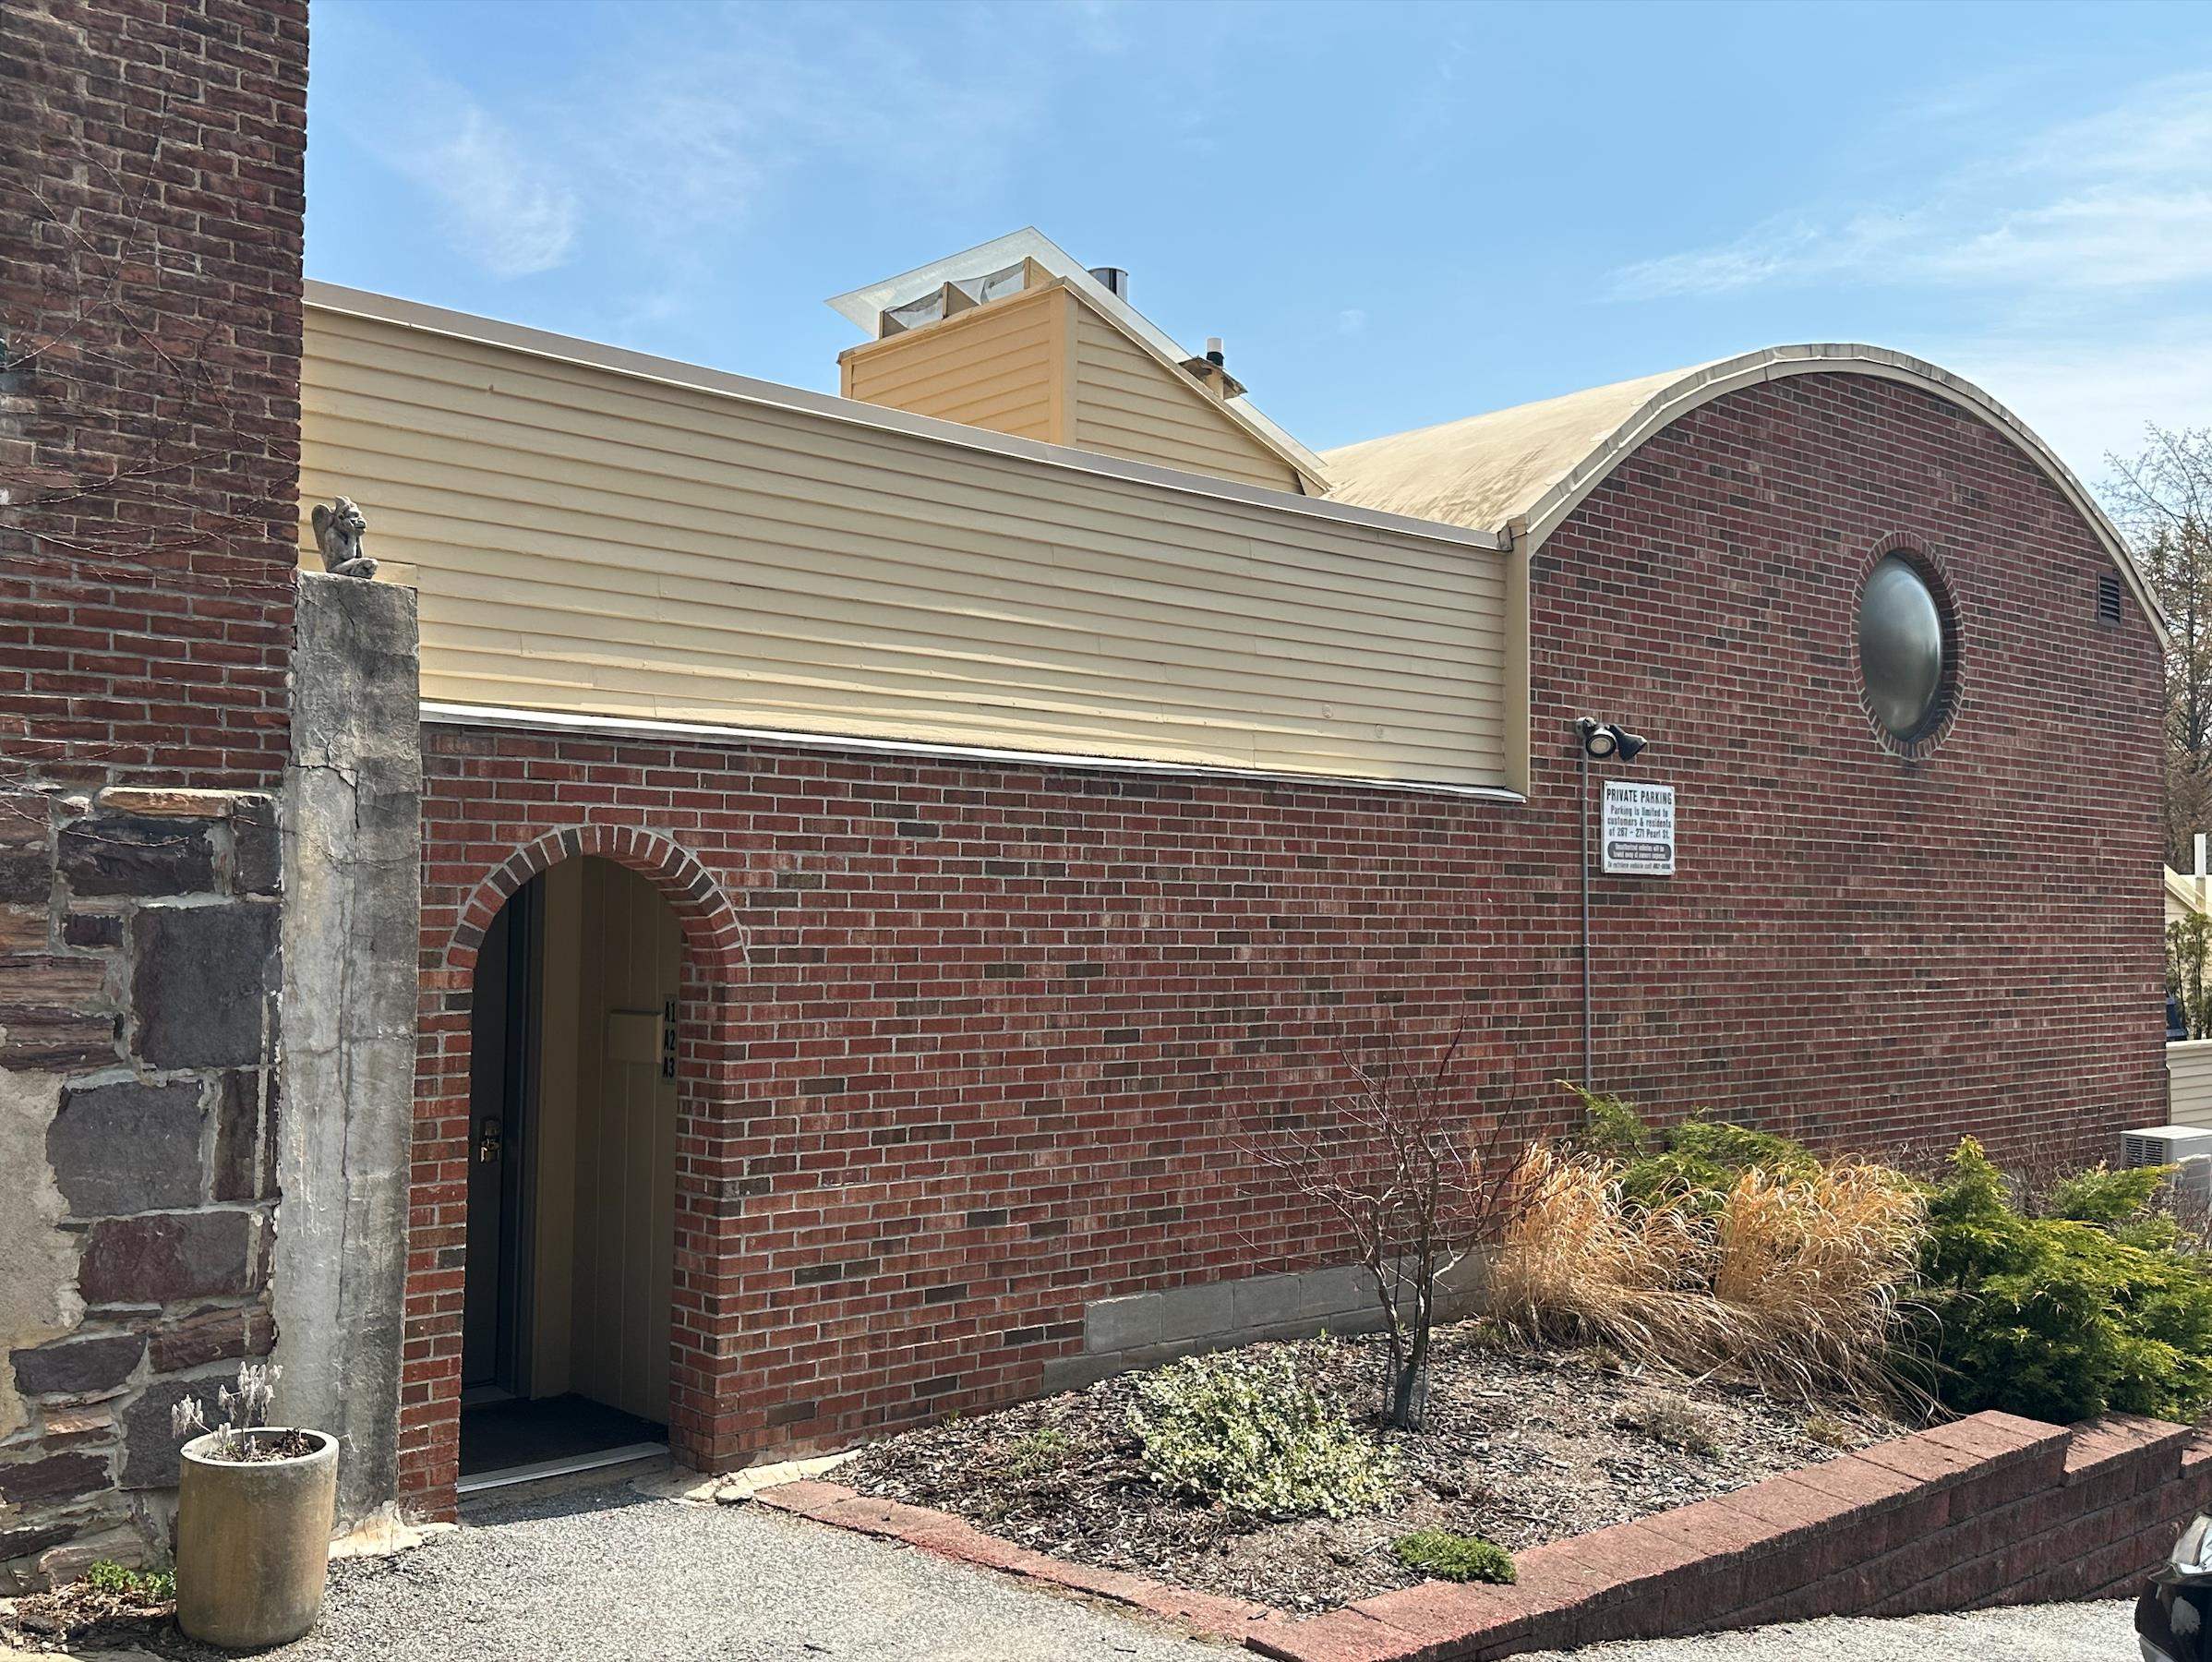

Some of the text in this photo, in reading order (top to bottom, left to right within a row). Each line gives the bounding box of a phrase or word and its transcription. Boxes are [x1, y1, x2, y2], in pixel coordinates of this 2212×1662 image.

[1606, 789, 1672, 805] PRIVATE PARKING
[1610, 804, 1668, 817] Parking is limited to
[1607, 816, 1672, 828] customers & residents
[1608, 827, 1616, 837] of
[1646, 828, 1661, 838] Pearl
[665, 1001, 675, 1023] A1
[664, 1029, 675, 1051] A2
[663, 1056, 675, 1078] A3
